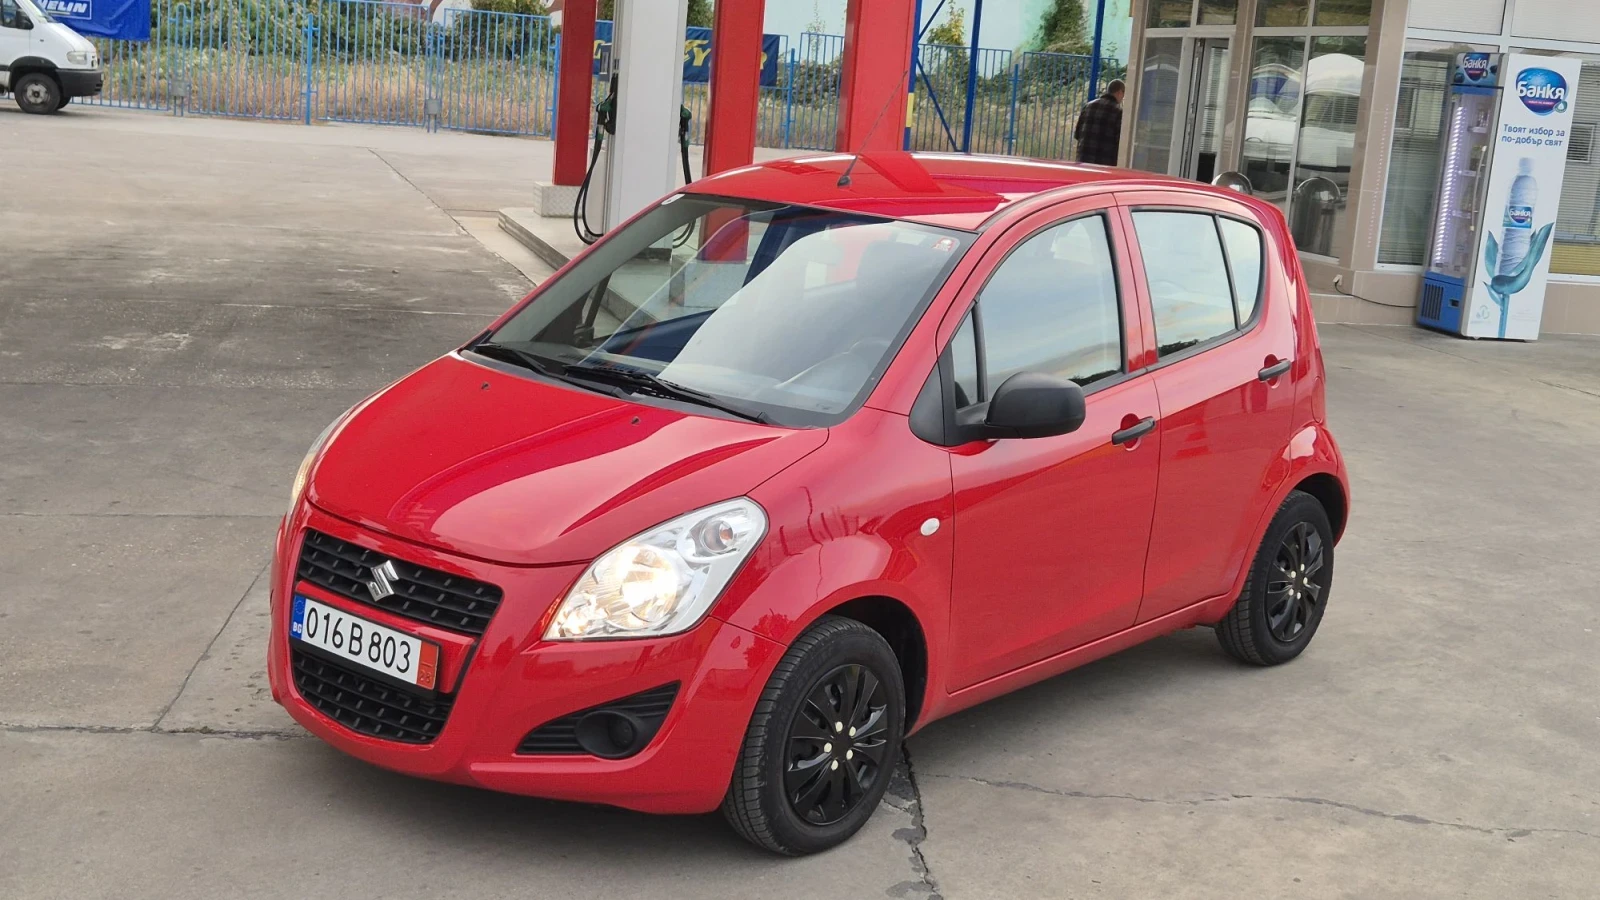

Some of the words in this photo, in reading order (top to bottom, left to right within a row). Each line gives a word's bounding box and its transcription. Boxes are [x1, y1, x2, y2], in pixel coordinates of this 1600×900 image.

[1504, 123, 1527, 134] Твоят
[1528, 126, 1554, 138] избор
[1555, 129, 1566, 137] за
[1501, 135, 1543, 147] по-добър
[1544, 139, 1564, 147] свят
[292, 621, 303, 634] BG
